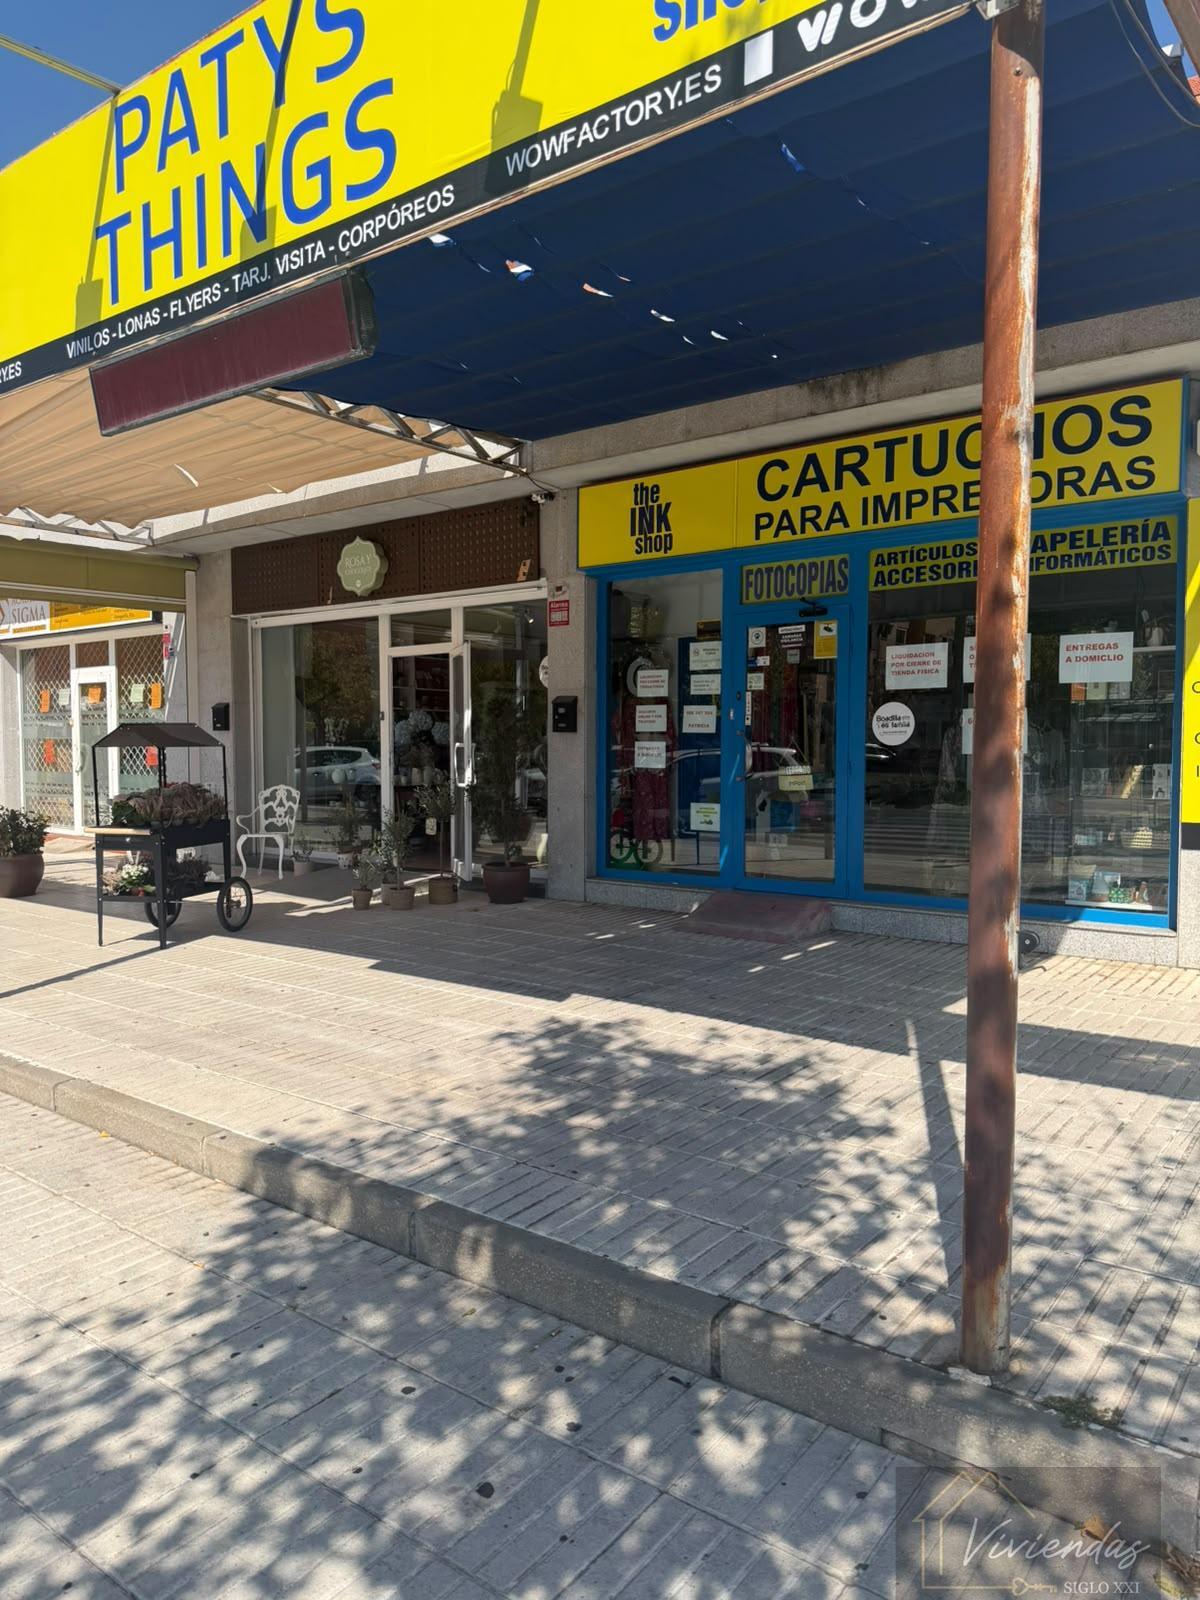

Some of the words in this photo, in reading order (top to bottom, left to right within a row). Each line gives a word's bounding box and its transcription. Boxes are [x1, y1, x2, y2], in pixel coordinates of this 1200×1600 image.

[112, 0, 366, 195] PATYS
[505, 63, 722, 177] WOWFACTORY.ES
[95, 77, 397, 307] THINGS
[66, 329, 111, 359] VINILOS
[118, 308, 161, 339] LONAS
[170, 282, 222, 320] FLYERS
[232, 266, 272, 293] TARJ.
[275, 240, 326, 275] VISITA
[337, 184, 455, 253] CORPÓREOS
[633, 482, 660, 506] the
[754, 501, 850, 541] PARA
[861, 455, 1156, 526] IMPREORAS
[629, 502, 672, 537] INK
[634, 531, 673, 556] shop
[873, 541, 978, 567] ARTÍCULOS
[1030, 519, 1171, 554] APELERÍA
[744, 557, 849, 601] FOTOCOPIAS
[873, 559, 978, 587] ACCESORI
[1030, 543, 1171, 572] FORMÁTICOS
[12, 605, 46, 624] SIGMA
[907, 660, 931, 668] CIERRE
[1065, 642, 1119, 652] ENTREGAS
[1075, 654, 1124, 663] DOMICLIO
[891, 669, 916, 677] TIENDA
